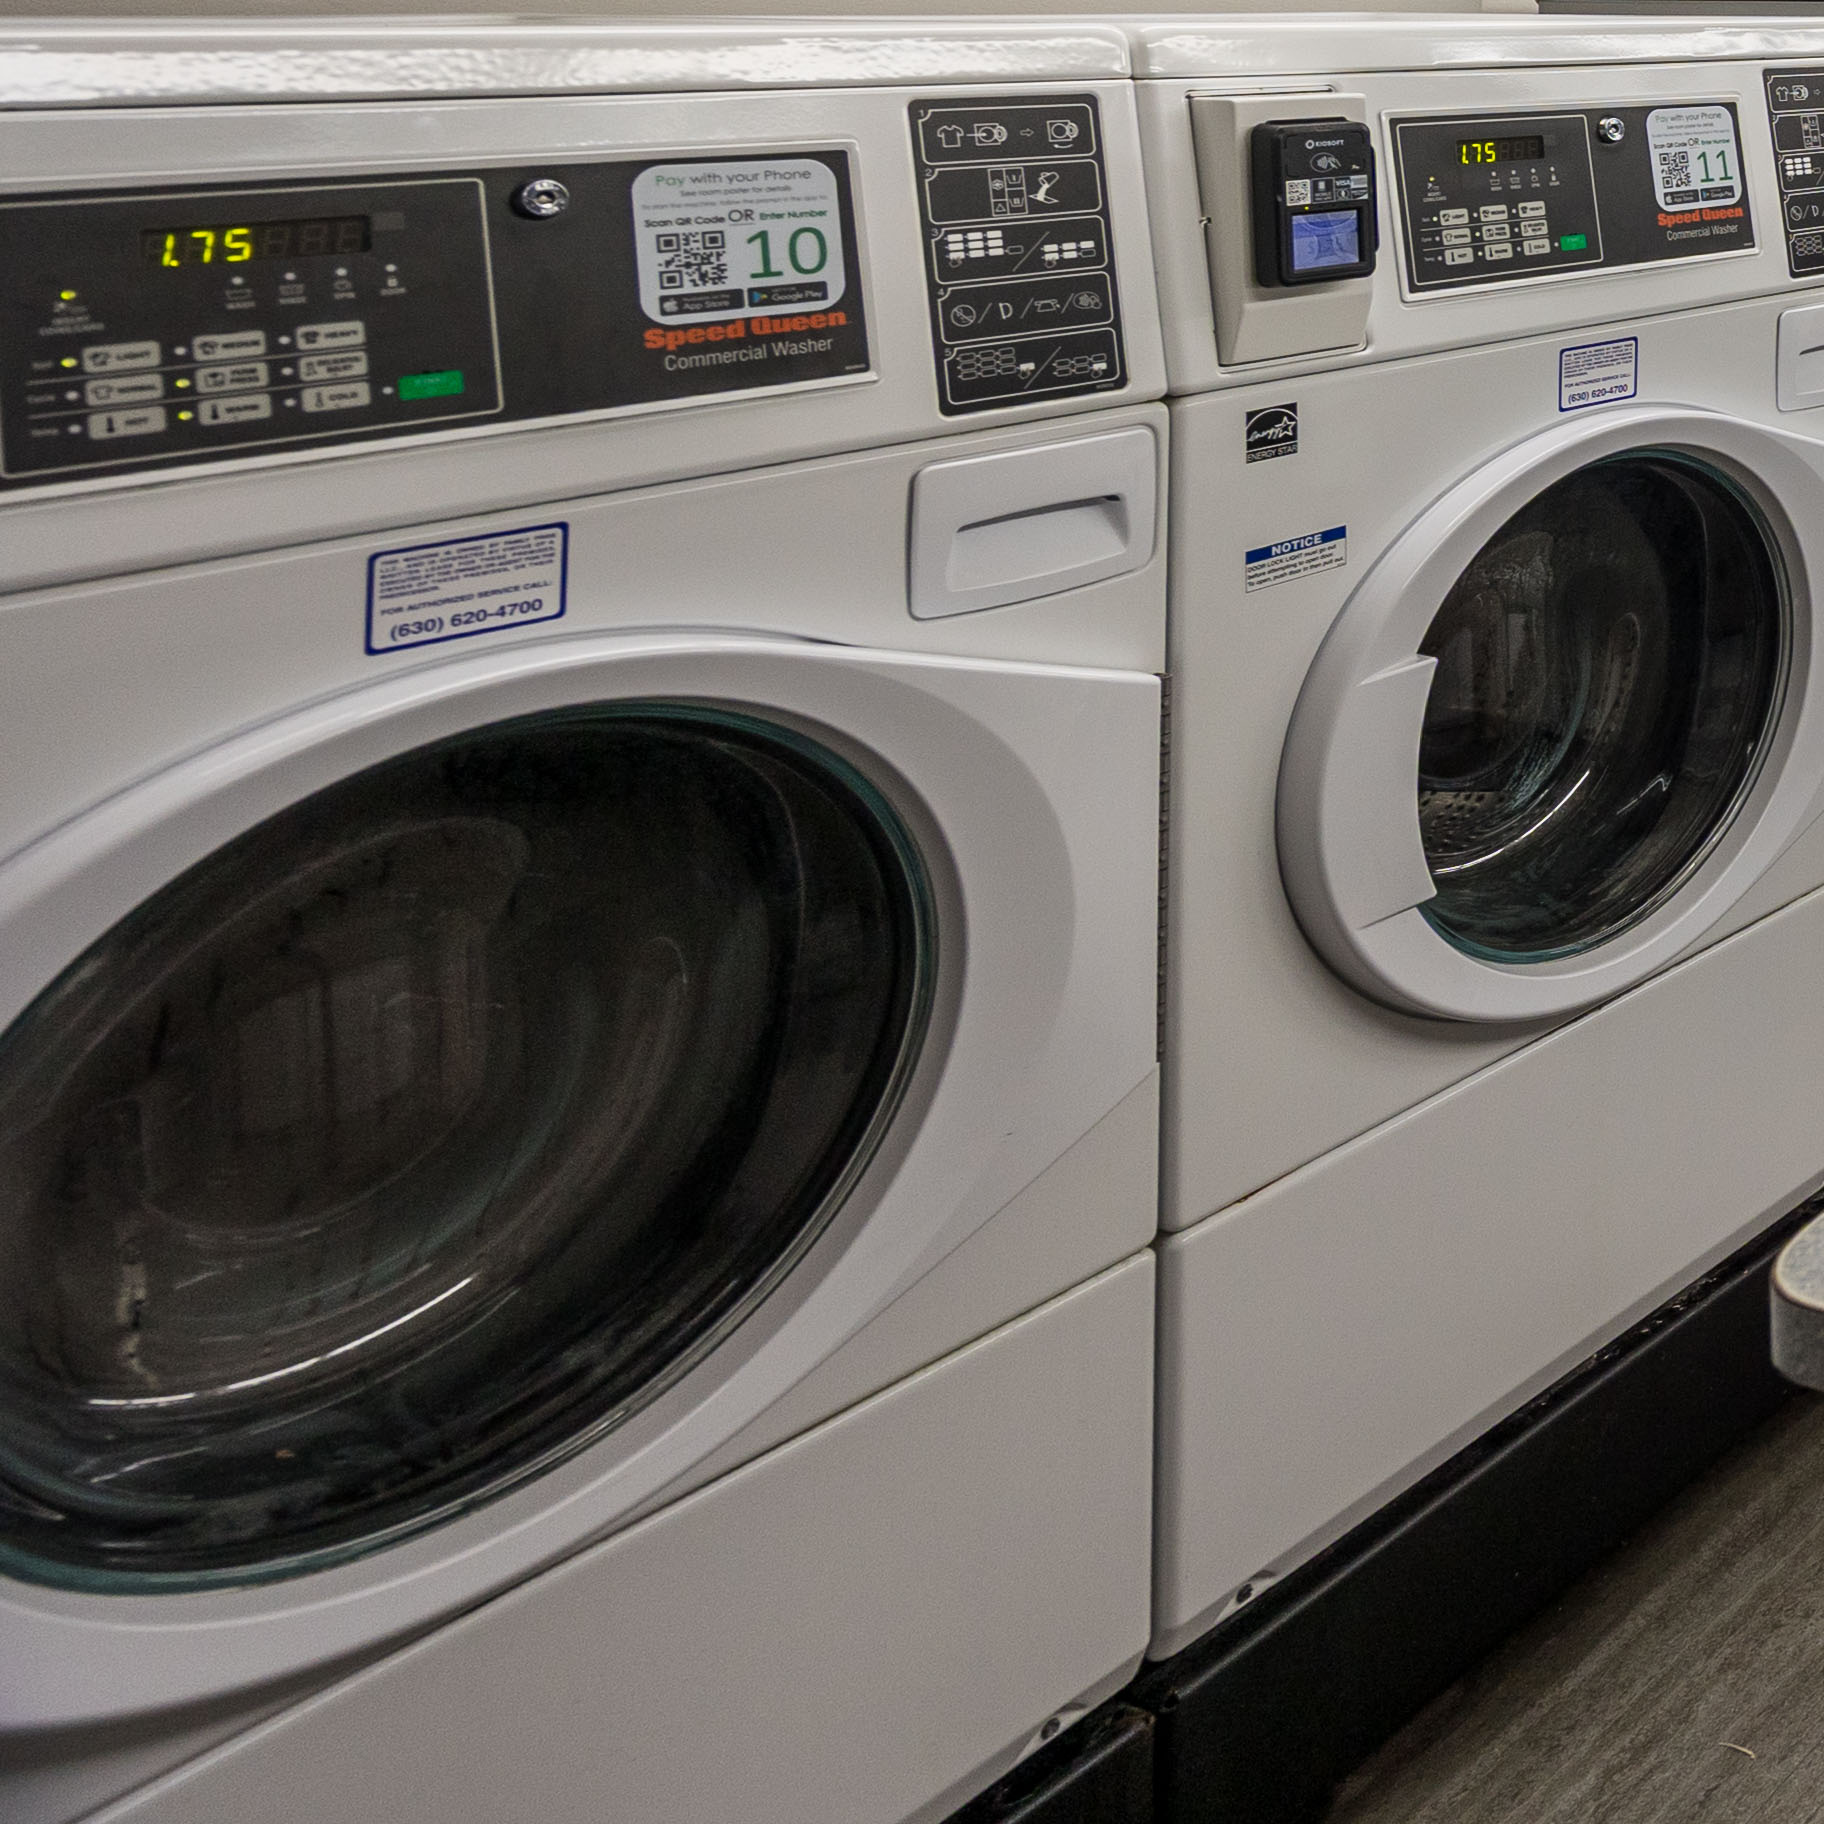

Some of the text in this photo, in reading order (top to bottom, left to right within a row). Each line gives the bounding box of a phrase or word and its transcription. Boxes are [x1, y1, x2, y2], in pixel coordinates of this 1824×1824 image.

[1655, 112, 1722, 125] Pay with your Phone
[1688, 138, 1700, 147] OR
[1697, 150, 1734, 183] 11
[655, 169, 812, 187] Pay with your Phone
[681, 189, 697, 197] See
[699, 188, 722, 196] room
[723, 187, 750, 196] poster
[765, 184, 792, 193] details
[644, 209, 828, 228] Scan QR Code OR Enter Number
[1657, 207, 1744, 228] Speed Queen
[1666, 224, 1739, 241] Commercial Washer
[746, 227, 828, 279] 10
[682, 298, 730, 312] App Store
[771, 288, 824, 303] Google Play
[643, 311, 847, 351] Speed Queen
[664, 338, 833, 372] Commercial Washer
[1568, 383, 1629, 405] (630) 620-4700
[1248, 443, 1298, 463] ENERGY STAR
[1271, 534, 1323, 556] NOTICE
[1248, 564, 1267, 573] DOOR
[1267, 559, 1285, 569] LOCK
[1285, 553, 1304, 564] LIGHT
[1304, 550, 1319, 558] must
[1248, 570, 1267, 580] before
[1267, 562, 1298, 577] attempting
[1305, 557, 1319, 566] open
[1320, 552, 1333, 561] door
[1273, 572, 1287, 582] push
[1288, 569, 1301, 577] door
[380, 580, 553, 616] FOR AUTHORIZED SERVICE CALL:
[390, 598, 543, 642] (630) 620-4700
